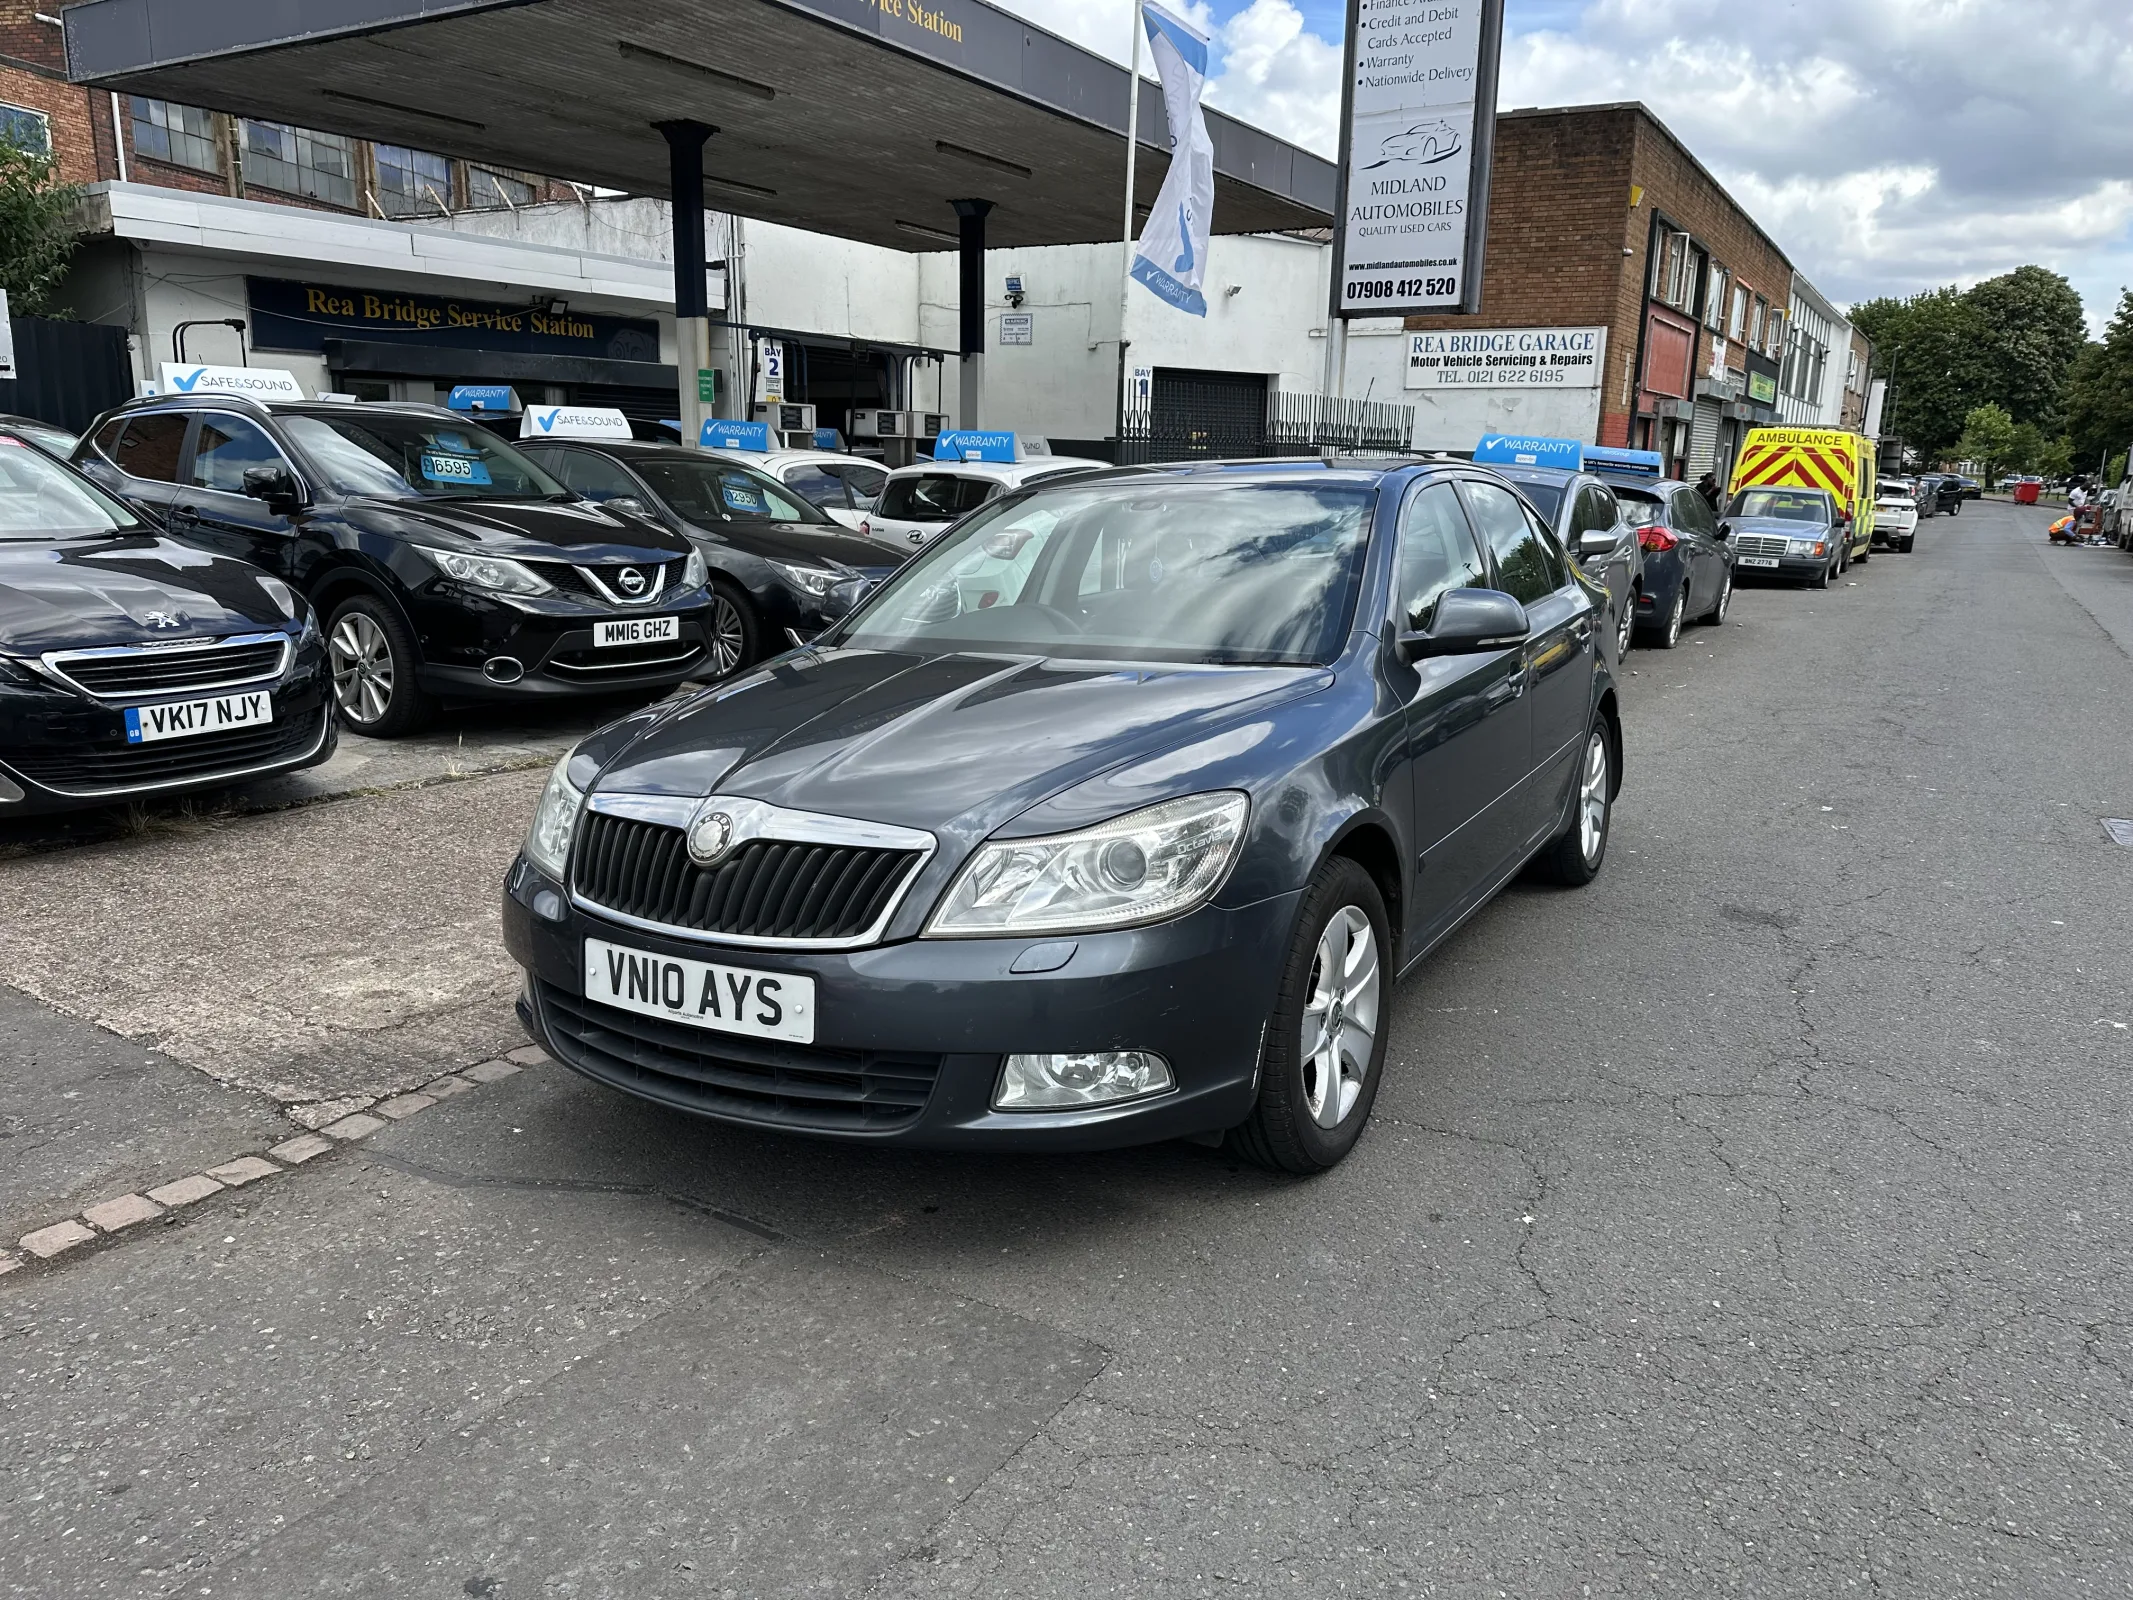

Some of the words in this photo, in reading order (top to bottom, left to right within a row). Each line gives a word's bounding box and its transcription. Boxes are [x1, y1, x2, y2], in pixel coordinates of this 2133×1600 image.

[907, 0, 963, 43] Station
[1368, 14, 1401, 30] Credit
[1404, 10, 1425, 26] and
[1428, 7, 1459, 22] Debit
[1367, 36, 1398, 49] Cards
[1400, 26, 1452, 46] Accepted
[1366, 53, 1414, 69] Warranty
[1365, 71, 1425, 88] Nationwide
[1428, 66, 1474, 81] Delivery
[1371, 176, 1446, 196] MIDLAND
[1351, 199, 1463, 221] AUTOMOBILES
[1358, 226, 1398, 237] QUALITY
[1400, 223, 1425, 234] USED
[1427, 222, 1452, 232] CARS
[1348, 258, 1458, 271] www.midlandautomobiles.co.uk
[1347, 280, 1393, 299] 07908
[1396, 279, 1423, 297] 412
[1426, 277, 1456, 296] 520
[305, 288, 355, 317] Rea
[363, 295, 441, 329] Bridge
[447, 304, 522, 332] Service
[530, 312, 595, 339] Station
[1413, 336, 1446, 353] REA
[1450, 334, 1515, 352] BRIDGE
[1519, 333, 1594, 351] GARAGE
[764, 347, 781, 356] BAY
[769, 358, 779, 376] 2
[1411, 356, 1440, 367] Motor
[1443, 355, 1483, 367] Vehicle
[1486, 354, 1536, 367] Servicing
[1539, 356, 1548, 365] &
[1550, 353, 1593, 366] Repairs
[1134, 369, 1151, 377] BAY
[1437, 371, 1464, 383] TEL.
[1467, 371, 1494, 383] 0121
[1498, 371, 1526, 382] 622
[1529, 369, 1564, 382] 6195
[200, 376, 293, 391] SAFE&SOUND
[464, 389, 506, 398] WARRANTY
[556, 415, 623, 427] SAFE&SOUND
[718, 424, 763, 437] WARRANTY
[955, 436, 1010, 447] WARRANTY
[1504, 439, 1575, 454] WARRANTY
[1757, 433, 1842, 446] AMBULANCE
[605, 623, 639, 642] MM16
[644, 620, 671, 639] GHZ
[150, 702, 208, 733] VK17
[216, 695, 261, 724] NJY
[129, 729, 140, 737] GB
[1177, 830, 1224, 854] Octavia
[606, 949, 685, 1010] VN10
[698, 969, 782, 1026] AYS
